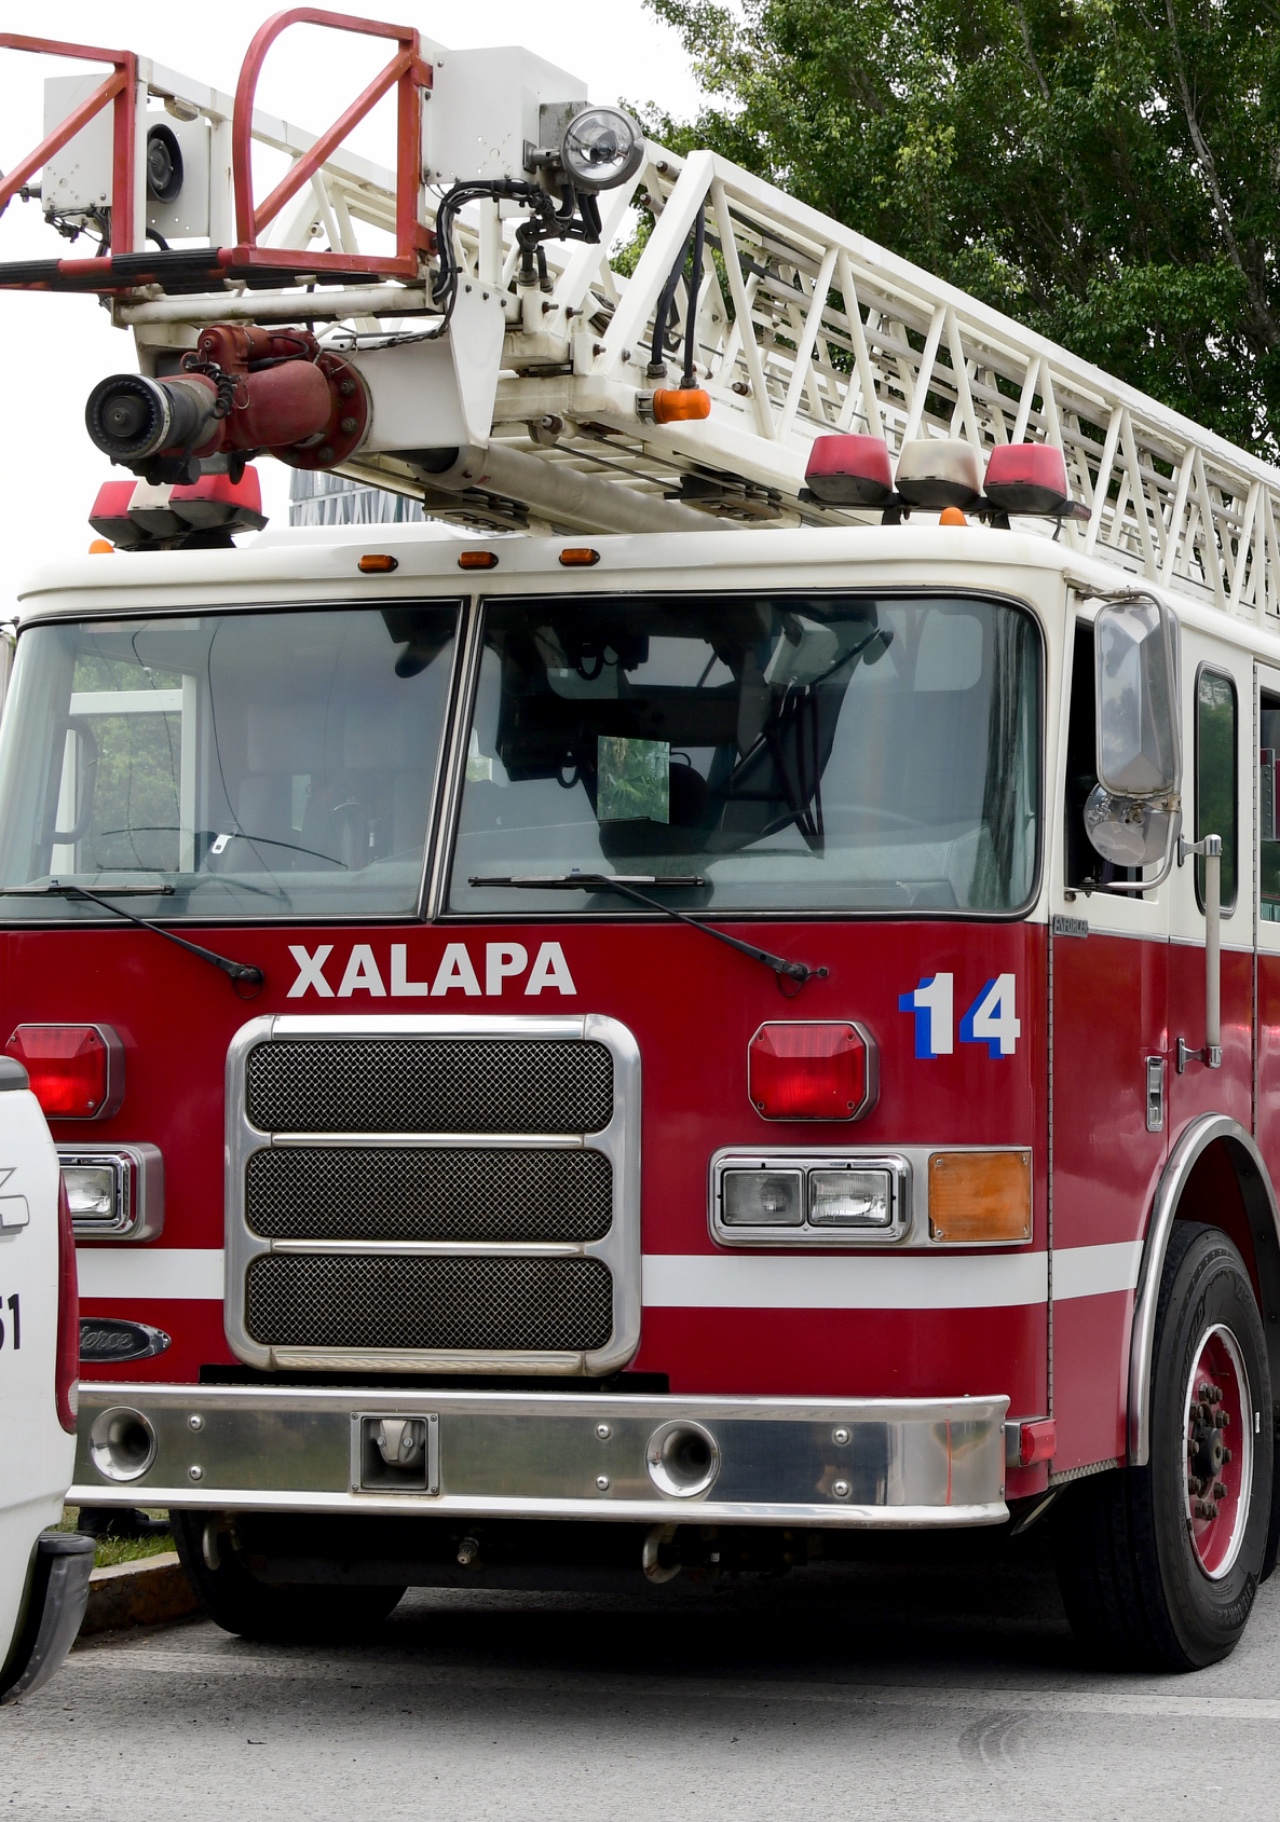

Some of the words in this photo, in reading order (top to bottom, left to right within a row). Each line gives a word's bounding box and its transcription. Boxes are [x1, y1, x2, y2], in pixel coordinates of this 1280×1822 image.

[287, 942, 578, 998] XALAPA
[898, 972, 1021, 1060] 14
[79, 1326, 134, 1350] ierce
